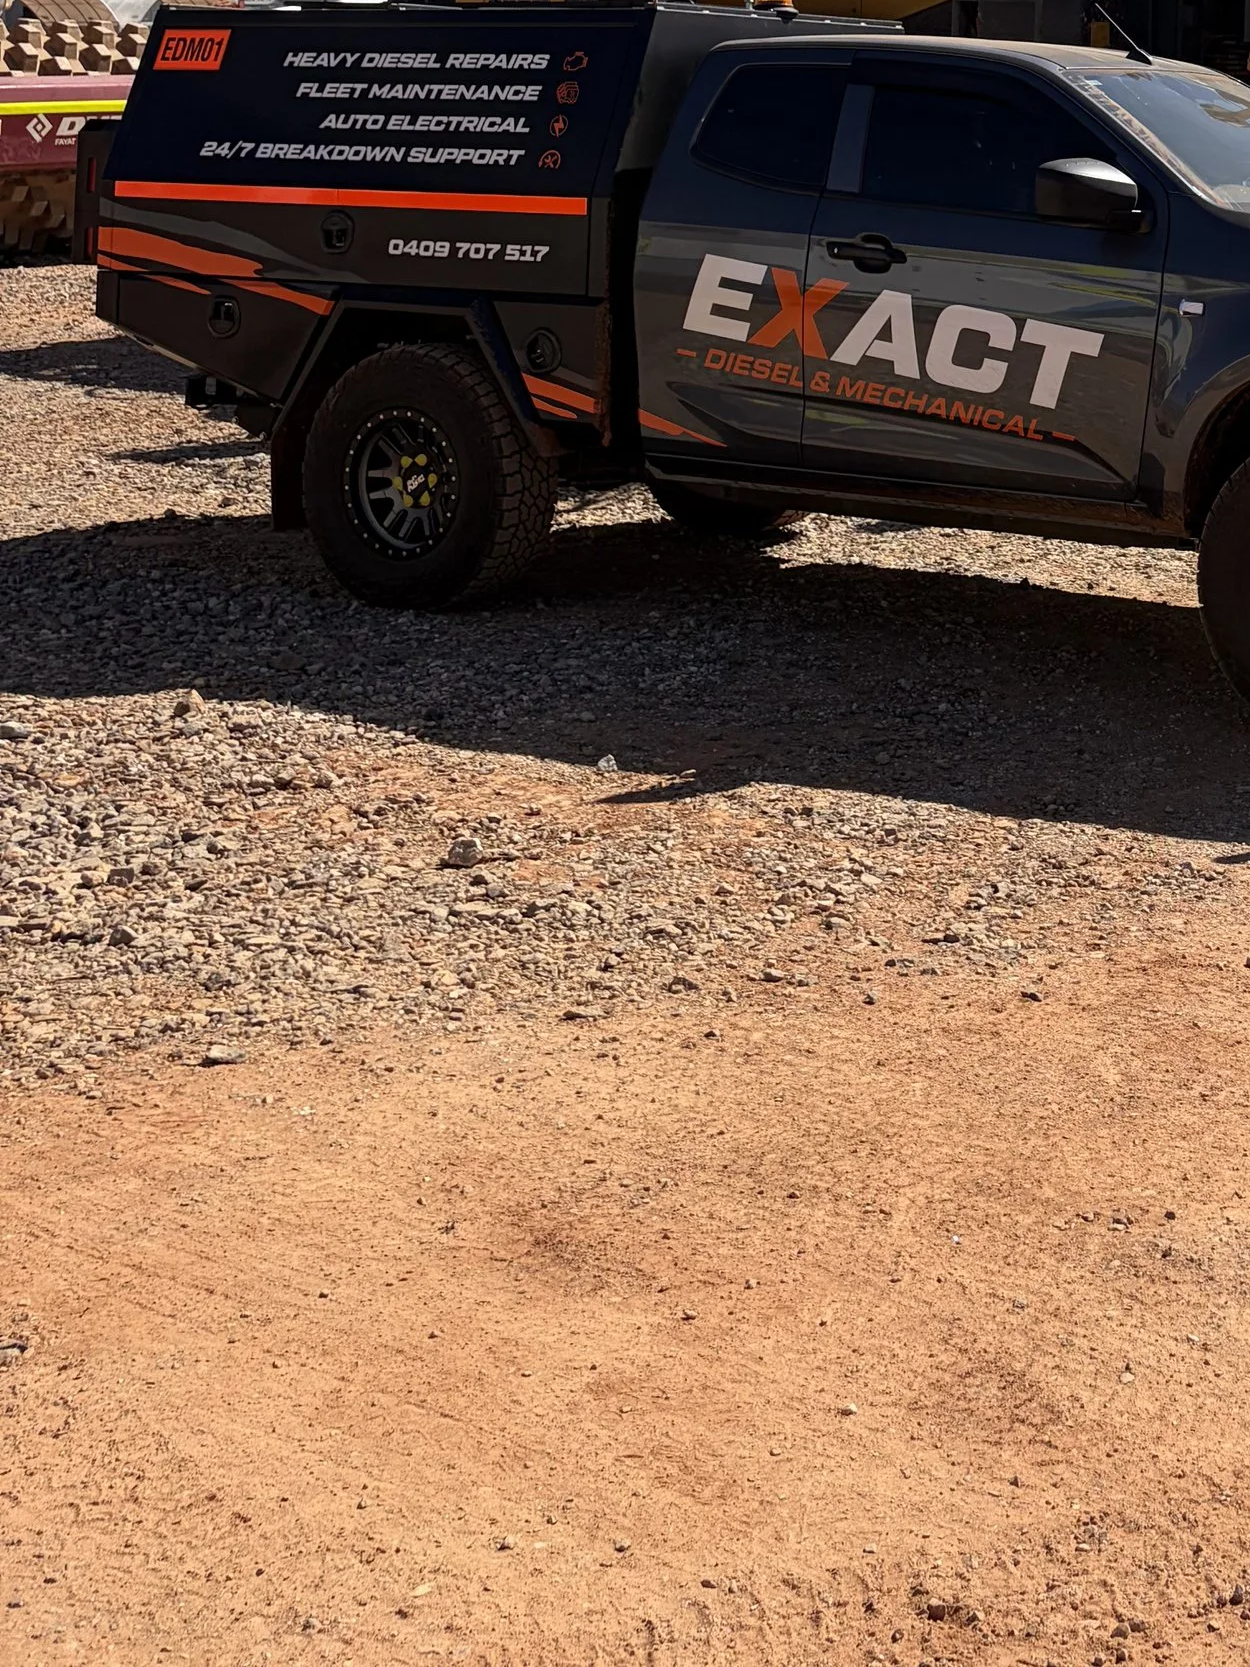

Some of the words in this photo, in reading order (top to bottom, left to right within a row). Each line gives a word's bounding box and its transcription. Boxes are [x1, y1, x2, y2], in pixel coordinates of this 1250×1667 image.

[160, 37, 225, 62] EDM01
[283, 52, 362, 68] HEAVY
[361, 53, 441, 69] DIESEL
[445, 53, 550, 70] REPAIRS
[296, 83, 368, 99] FLEET
[368, 83, 543, 101] MAINTENANCE
[319, 114, 385, 130] AUTO
[386, 114, 531, 133] ELECTRICAL
[54, 137, 77, 146] FAYAT
[199, 140, 256, 159] 24/7
[255, 143, 406, 163] BREAKDOWN
[407, 146, 526, 166] SUPPORT
[388, 239, 450, 258] 0409
[455, 242, 501, 260] 707
[504, 244, 550, 262] 517
[682, 253, 1105, 410] EXACT
[704, 348, 804, 387] DIESEL
[809, 371, 831, 393] &
[836, 377, 1044, 441] MECHANICAL
